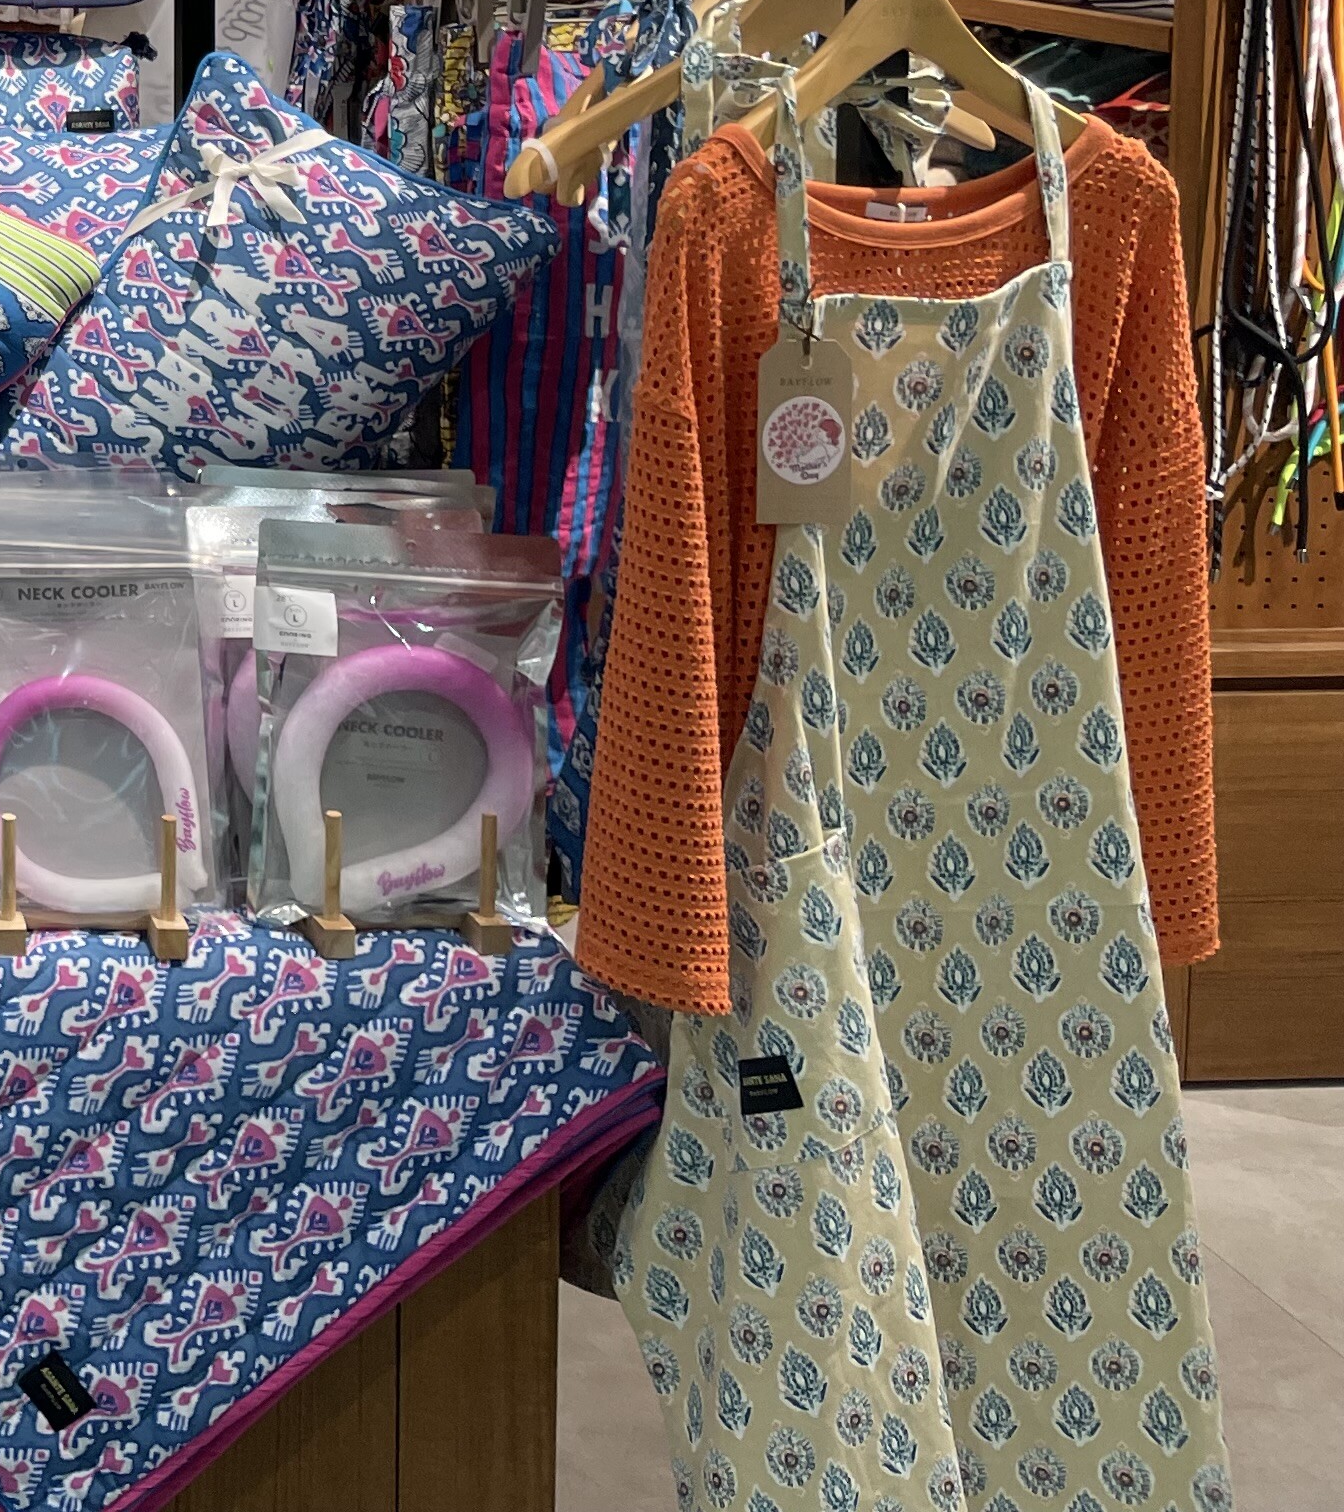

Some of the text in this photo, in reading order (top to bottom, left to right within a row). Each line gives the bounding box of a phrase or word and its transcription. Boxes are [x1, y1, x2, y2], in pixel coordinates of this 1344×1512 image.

[18, 584, 140, 601] NECK COOLER
[383, 724, 444, 742] COOLER
